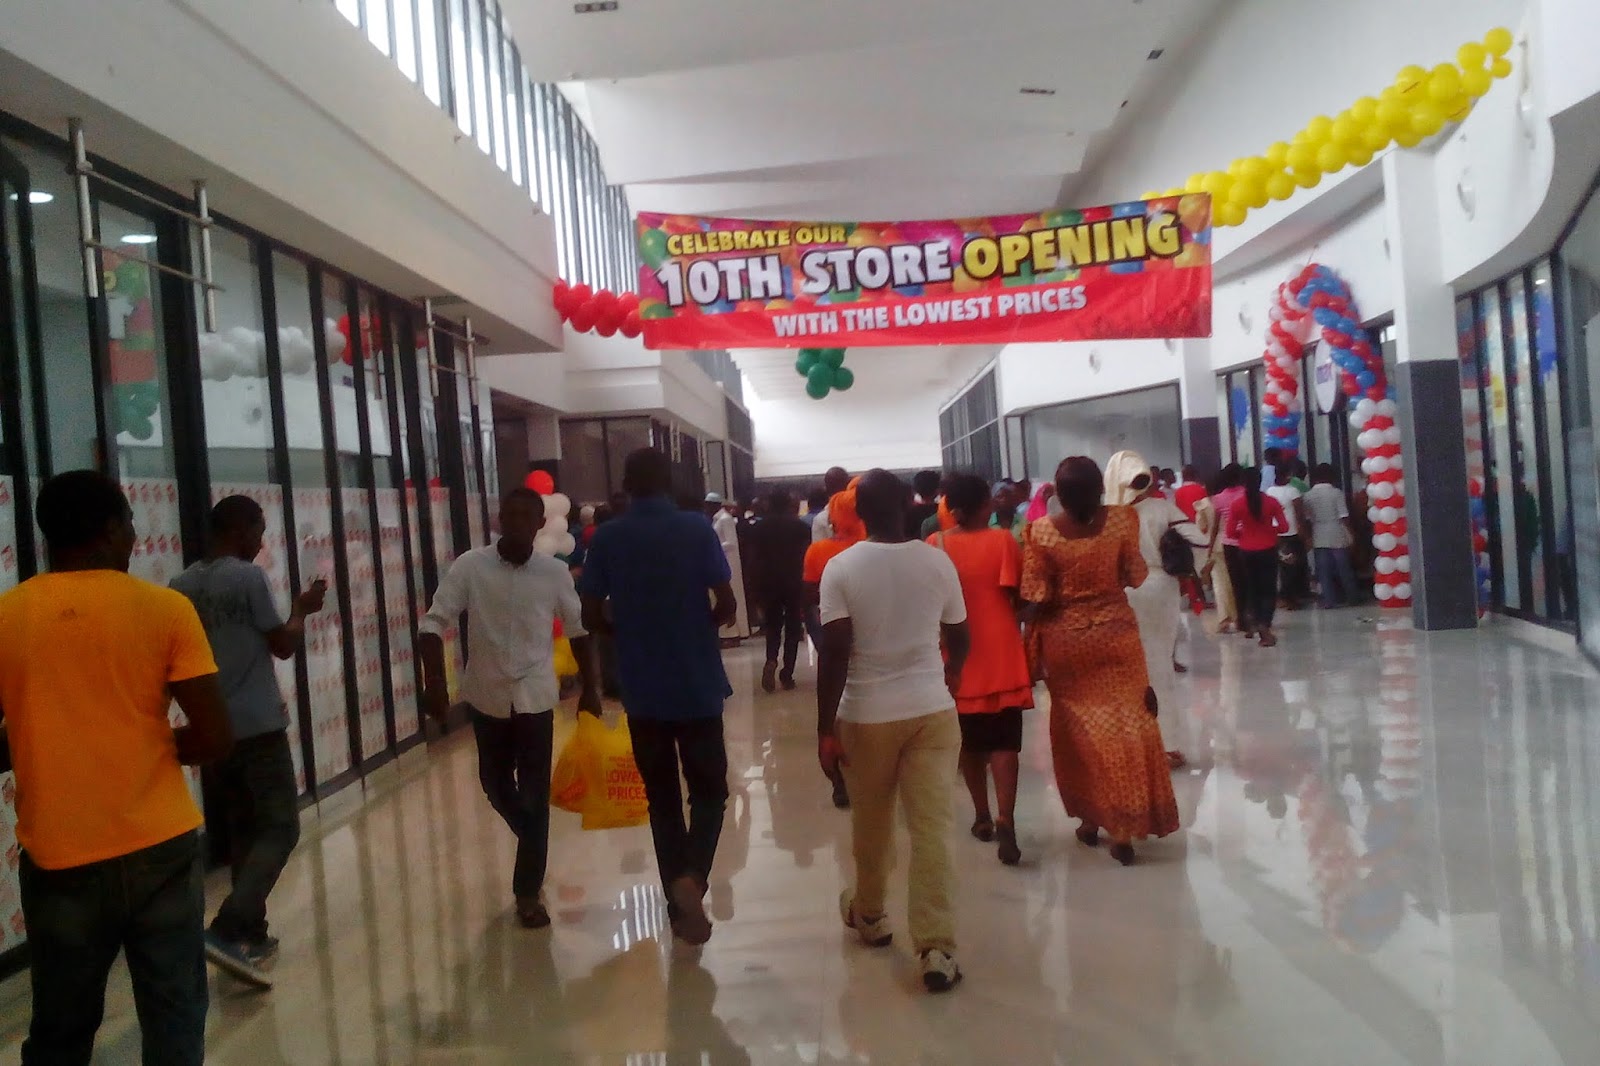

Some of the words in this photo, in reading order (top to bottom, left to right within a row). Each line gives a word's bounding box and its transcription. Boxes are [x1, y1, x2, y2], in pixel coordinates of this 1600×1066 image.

[656, 253, 784, 307] 10TH
[800, 239, 954, 296] STORE
[962, 211, 1184, 279] OPENING
[666, 228, 791, 256] CELEBRATE
[795, 224, 848, 245] OUR
[772, 311, 839, 338] WITH
[842, 307, 890, 331] THE
[895, 296, 992, 326] LOWEST
[998, 285, 1087, 317] PRICES
